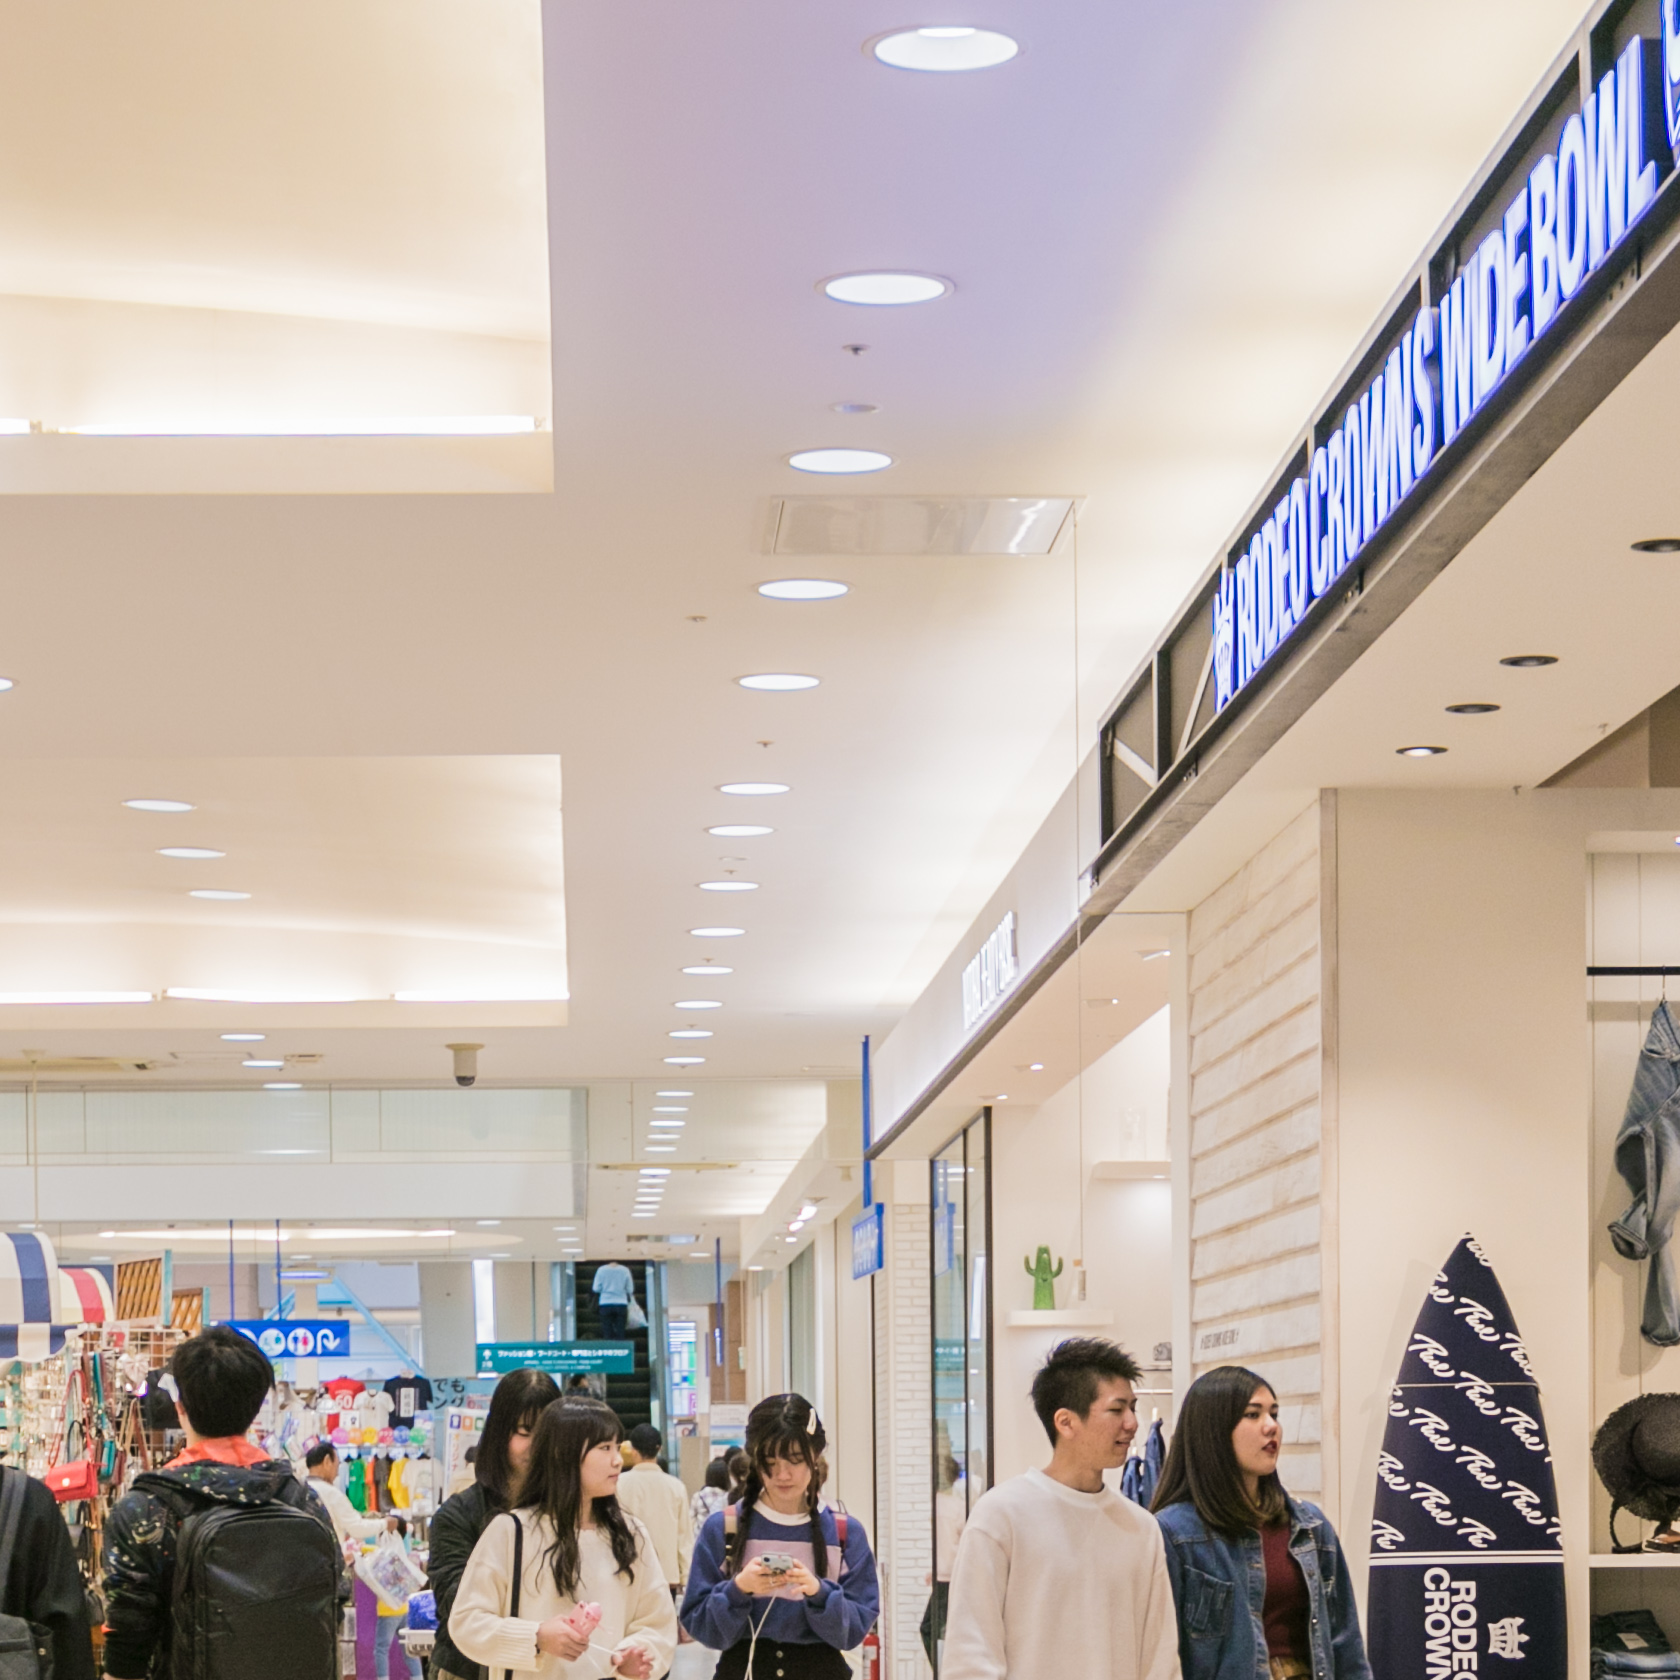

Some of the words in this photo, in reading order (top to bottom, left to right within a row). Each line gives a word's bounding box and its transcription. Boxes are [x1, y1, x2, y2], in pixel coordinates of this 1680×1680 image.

[1233, 477, 1309, 689] RODEO
[1309, 306, 1436, 597] CROWNS
[1438, 187, 1530, 446] WIDE
[1529, 34, 1658, 340] BOWL
[433, 1378, 465, 1394] でも
